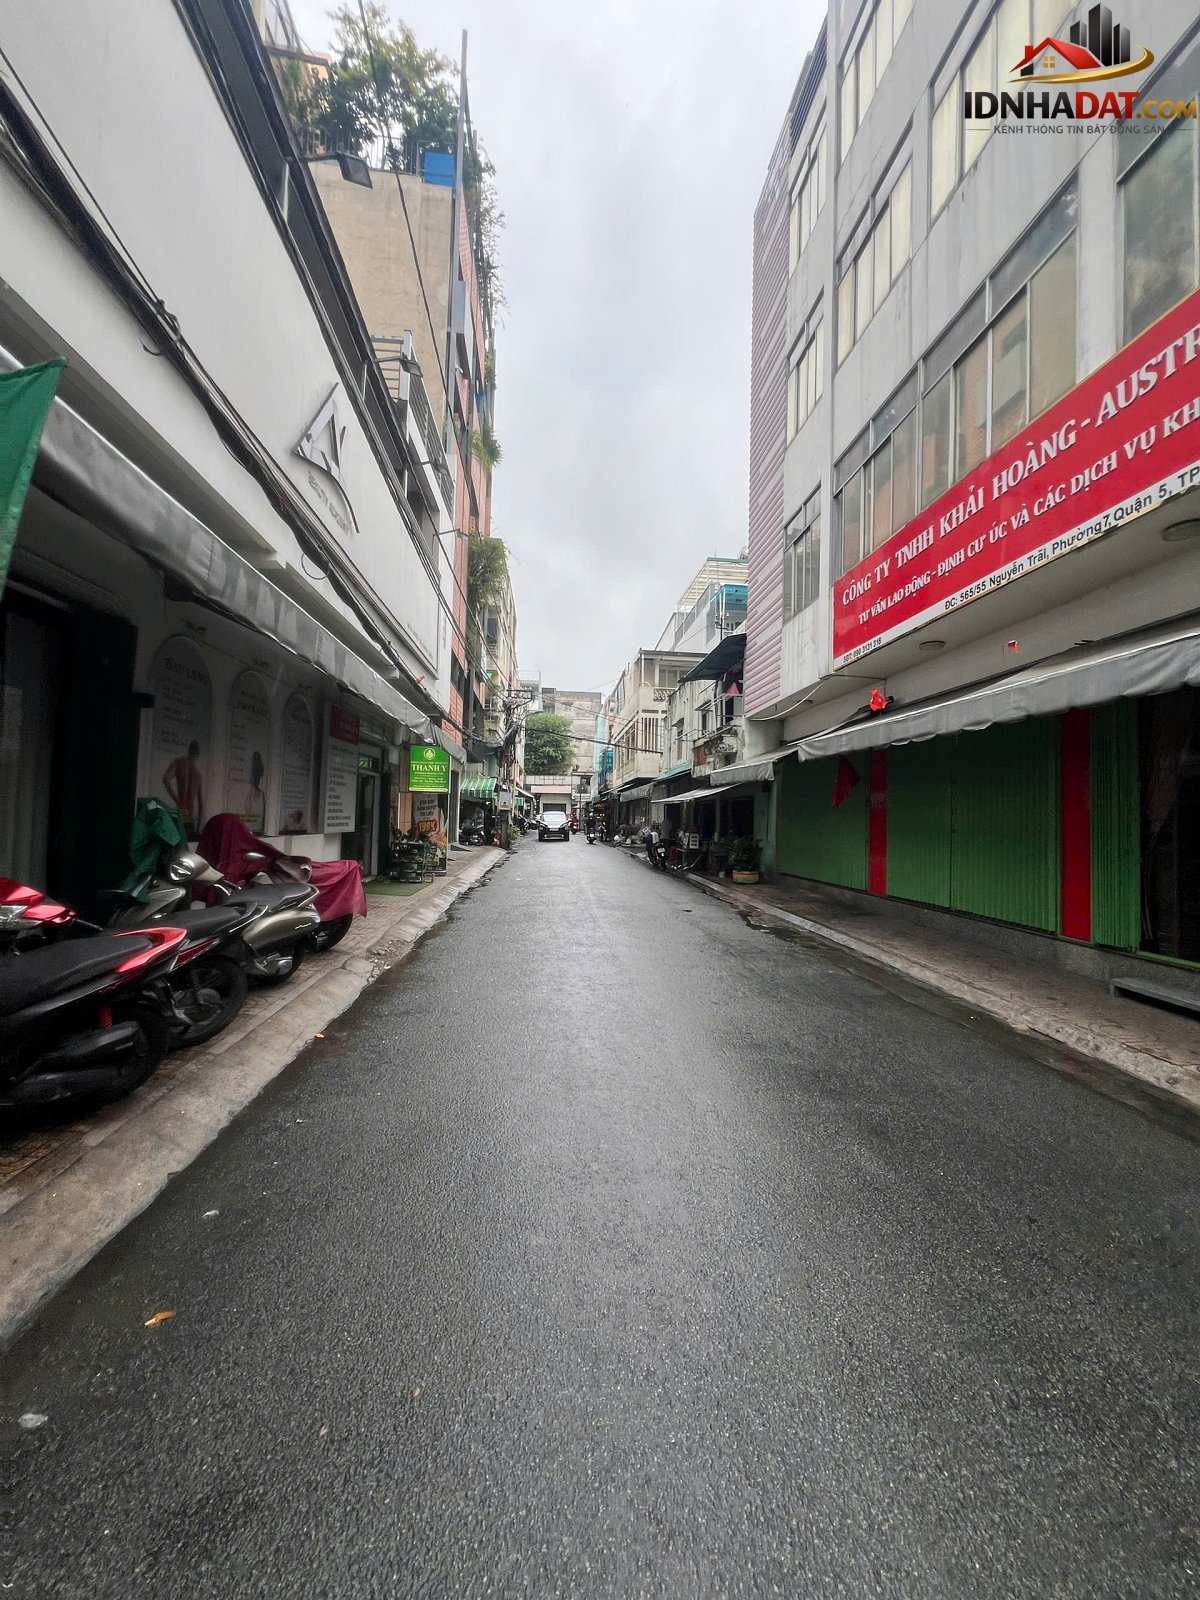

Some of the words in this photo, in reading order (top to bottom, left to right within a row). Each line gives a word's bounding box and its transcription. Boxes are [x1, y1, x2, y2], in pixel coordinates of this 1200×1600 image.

[842, 573, 872, 606] CÔNG
[874, 558, 891, 584] TY
[895, 525, 934, 568] TNHH
[939, 484, 985, 538] KHẢI
[992, 418, 1078, 500] HOÀNG
[858, 610, 871, 625] TƯ
[871, 596, 887, 618] VẤN
[887, 589, 904, 607] LAO
[905, 571, 931, 597] ĐỘNG
[937, 548, 965, 577] ĐỊNH
[967, 534, 987, 558] CƯ
[989, 517, 1007, 544] ÚC
[1010, 503, 1031, 531] VÀ
[1033, 484, 1066, 516] CÁC
[1070, 450, 1118, 495] DỊCH
[1123, 424, 1157, 460] VỤ
[945, 597, 958, 611] ĐC:
[960, 583, 986, 603] 565/55
[989, 561, 1024, 588] Nguyễn
[1027, 549, 1050, 568] Trãi,
[1113, 495, 1152, 522] Quận
[1158, 482, 1172, 499] 5,
[412, 764, 440, 772] THANH
[441, 764, 447, 772] Y
